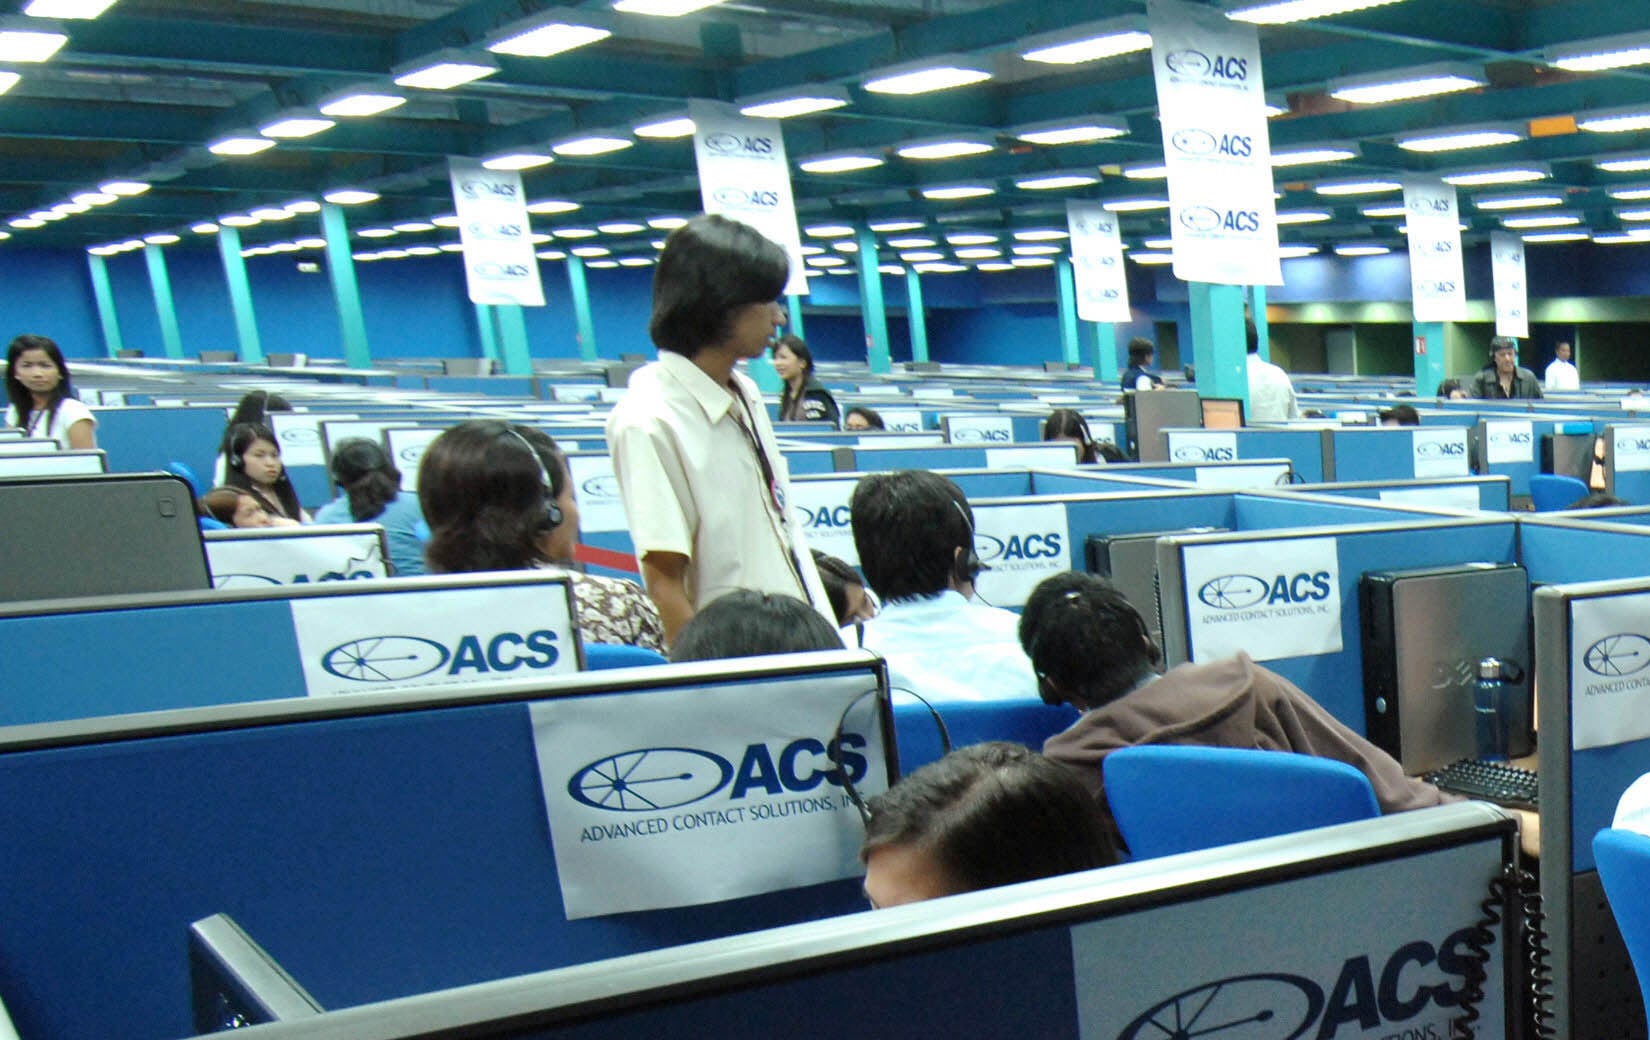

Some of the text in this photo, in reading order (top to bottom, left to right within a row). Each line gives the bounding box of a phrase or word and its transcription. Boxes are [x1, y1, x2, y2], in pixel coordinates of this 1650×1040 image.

[1212, 55, 1248, 80] ACS
[744, 137, 772, 154] ACS
[1219, 134, 1252, 157] ACS
[751, 191, 779, 207] ACS
[1223, 210, 1260, 232] ACS
[1206, 447, 1233, 461] ACS
[814, 505, 851, 528] AC
[1003, 533, 1062, 560] ACS
[1267, 571, 1331, 605] ACS
[448, 630, 560, 675] ACS
[729, 733, 868, 800] ACS
[580, 817, 669, 843] ADVANCED
[674, 807, 747, 831] CONTACT
[751, 797, 838, 821] SOLUTIONS,
